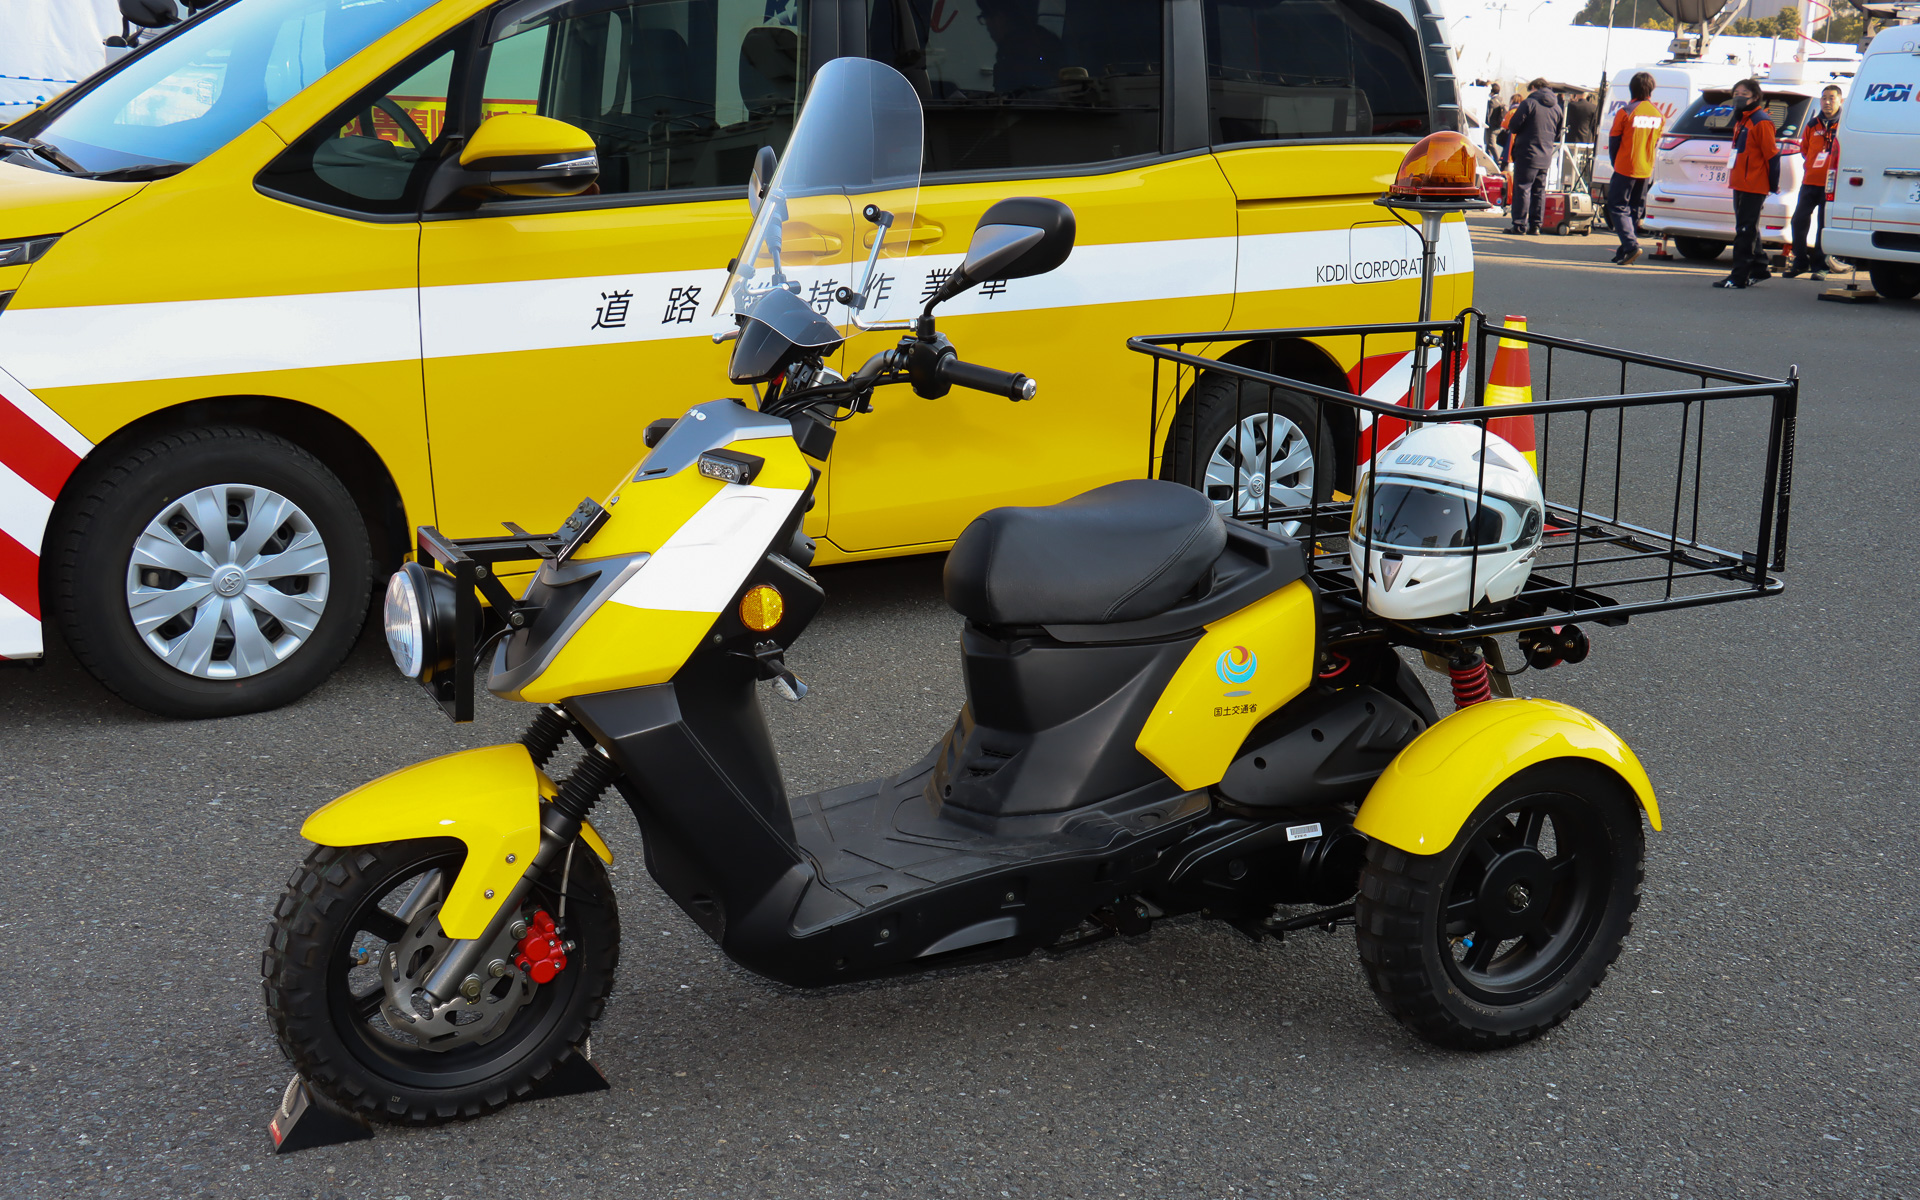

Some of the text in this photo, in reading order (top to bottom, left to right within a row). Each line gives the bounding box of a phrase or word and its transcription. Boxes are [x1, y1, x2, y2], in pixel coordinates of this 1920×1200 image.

[1864, 83, 1913, 102] KDDI
[1316, 263, 1348, 283] KDDI
[1213, 703, 1258, 718] 国土交通省
